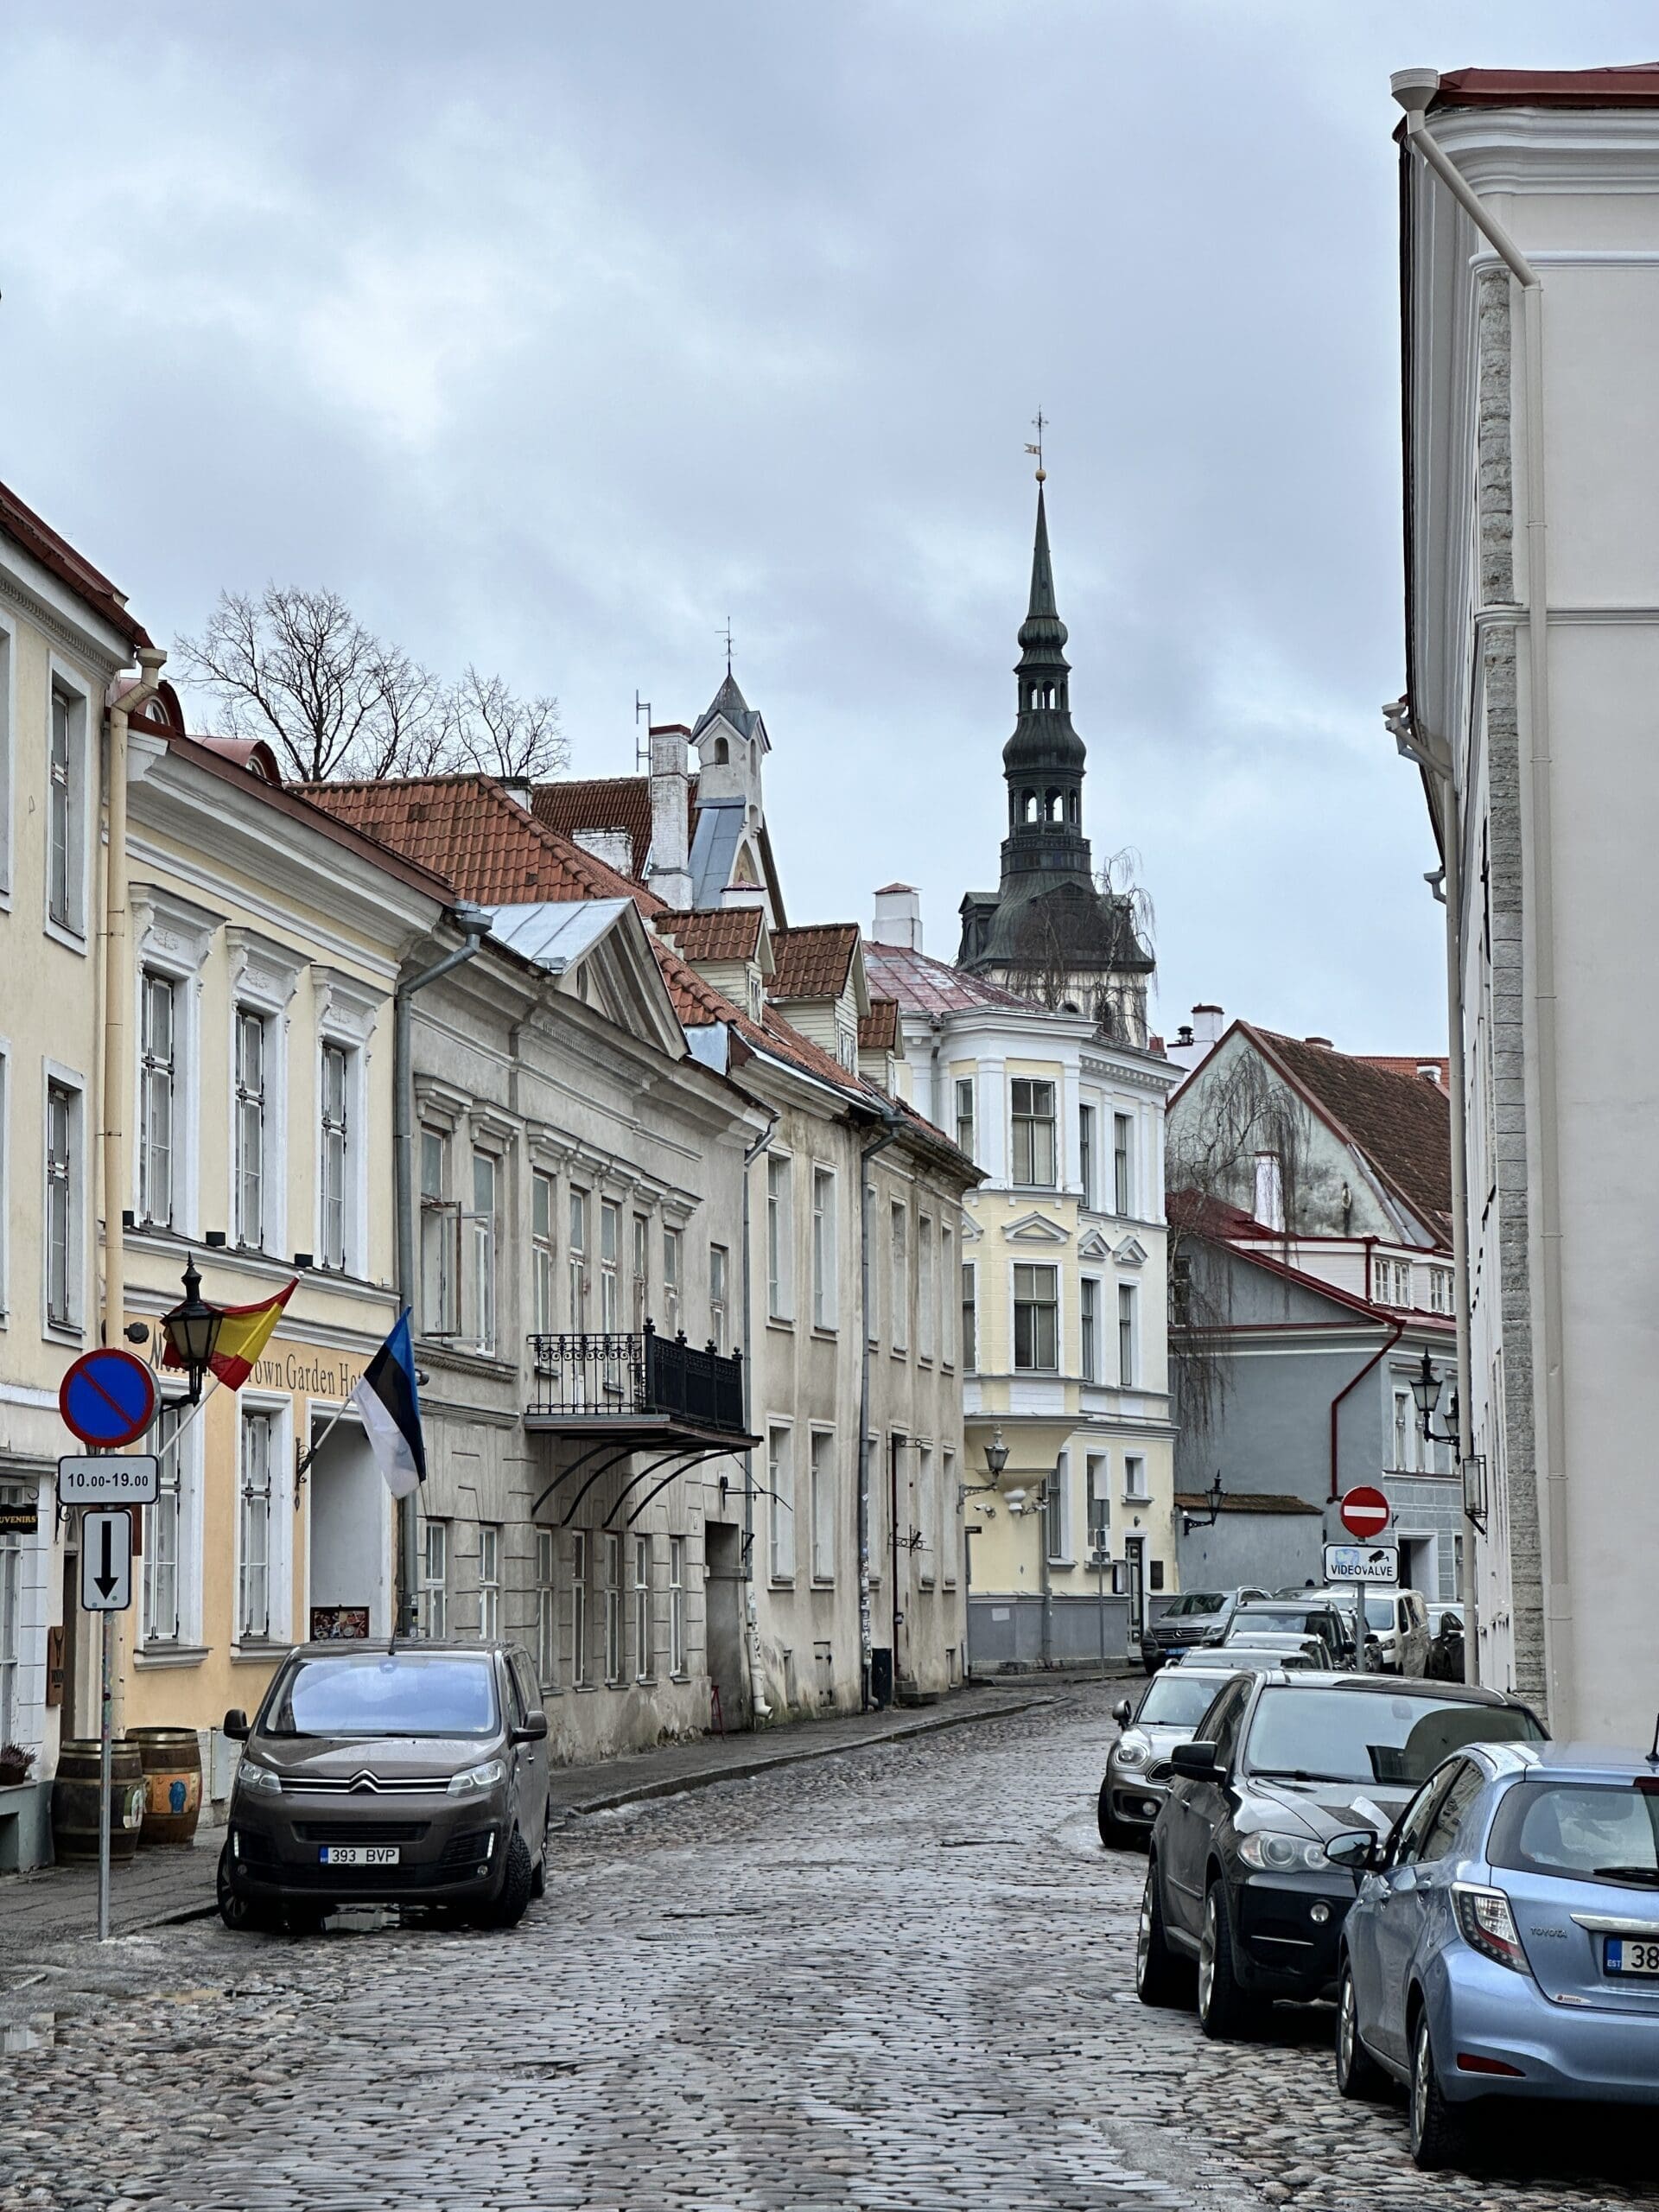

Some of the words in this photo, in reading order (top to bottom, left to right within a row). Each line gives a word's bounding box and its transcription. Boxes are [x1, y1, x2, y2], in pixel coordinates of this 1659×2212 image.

[286, 1353, 335, 1395] Garden
[67, 1472, 149, 1487] 10.00-19.00
[1331, 1564, 1393, 1577] VIDEOVALVE
[332, 1849, 356, 1863] 393
[366, 1849, 396, 1863] BVP
[1530, 1927, 1567, 1939] TOYOTA
[1607, 1959, 1622, 1967] EST
[1630, 1944, 1659, 1970] 38
